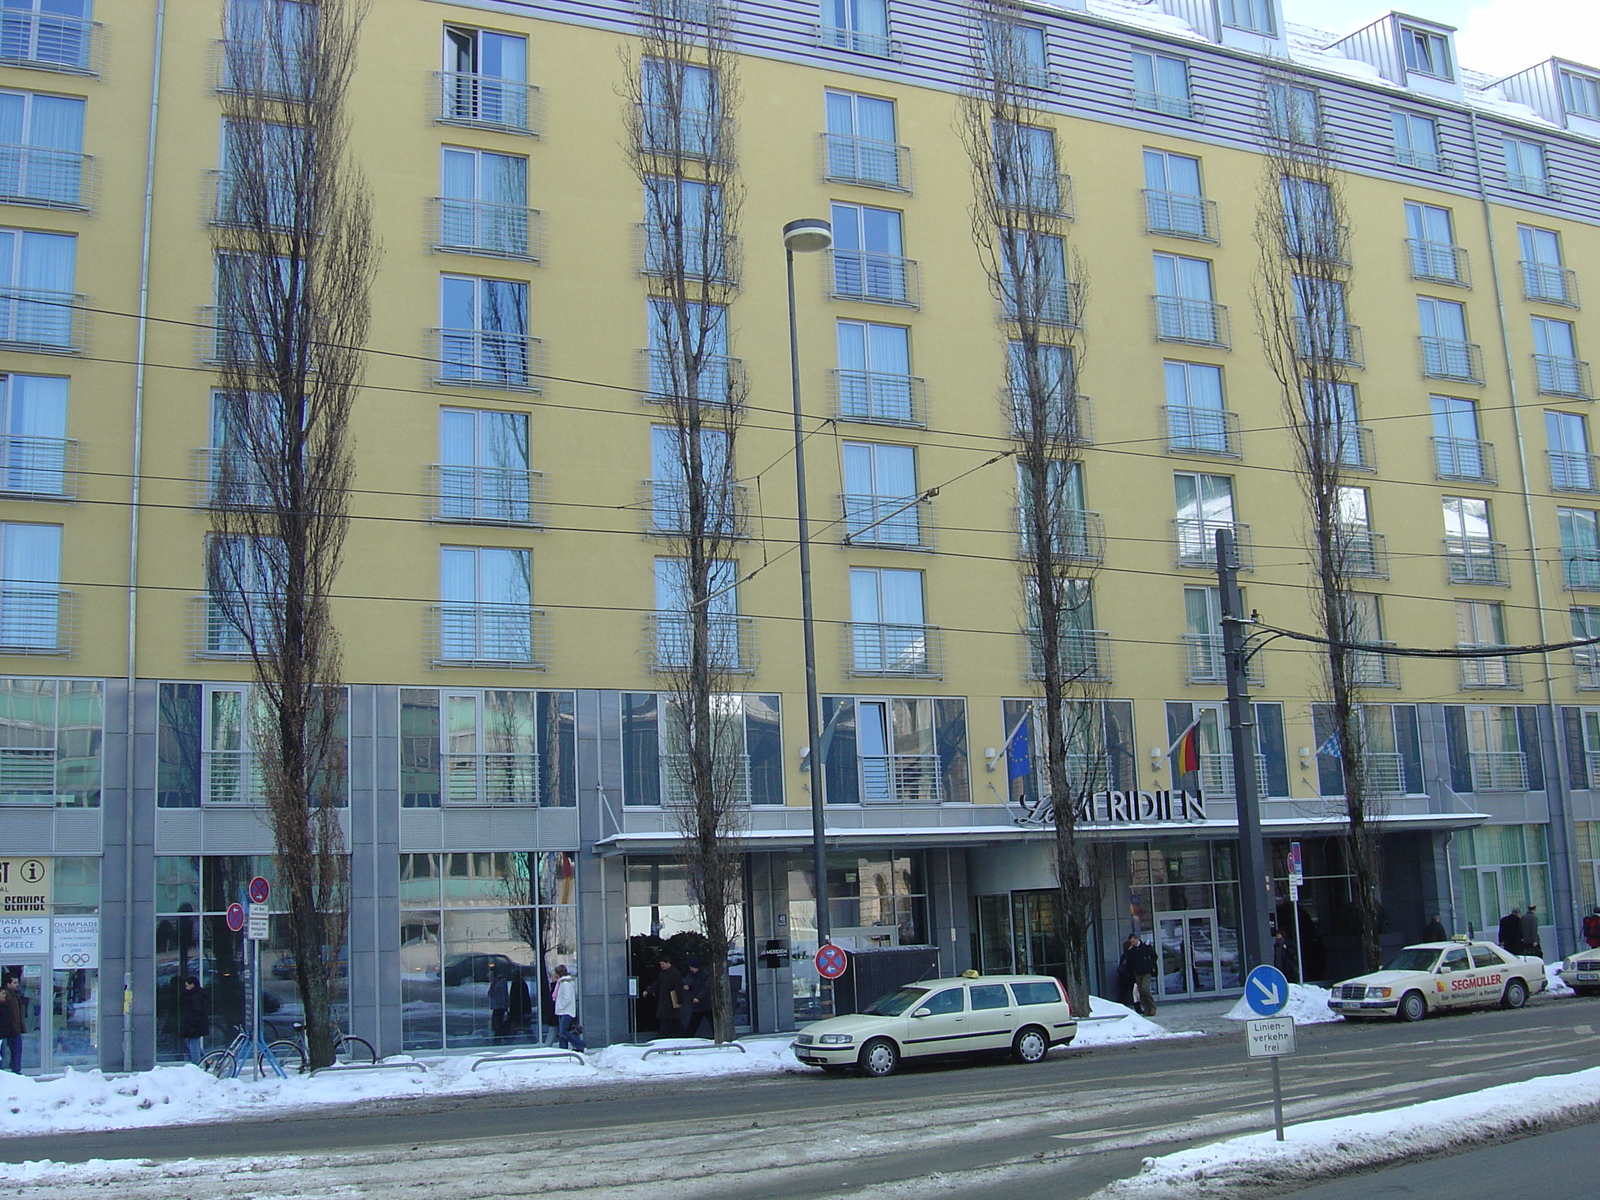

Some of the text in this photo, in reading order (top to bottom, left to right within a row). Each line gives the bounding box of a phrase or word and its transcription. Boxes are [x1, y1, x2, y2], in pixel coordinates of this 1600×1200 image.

[4, 896, 45, 911] SERVICE
[3, 925, 44, 934] GAMES
[3, 941, 34, 949] GREECE
[1254, 1023, 1285, 1031] Linien-
[1253, 1032, 1288, 1042] verkehr
[1264, 1043, 1280, 1052] frei
